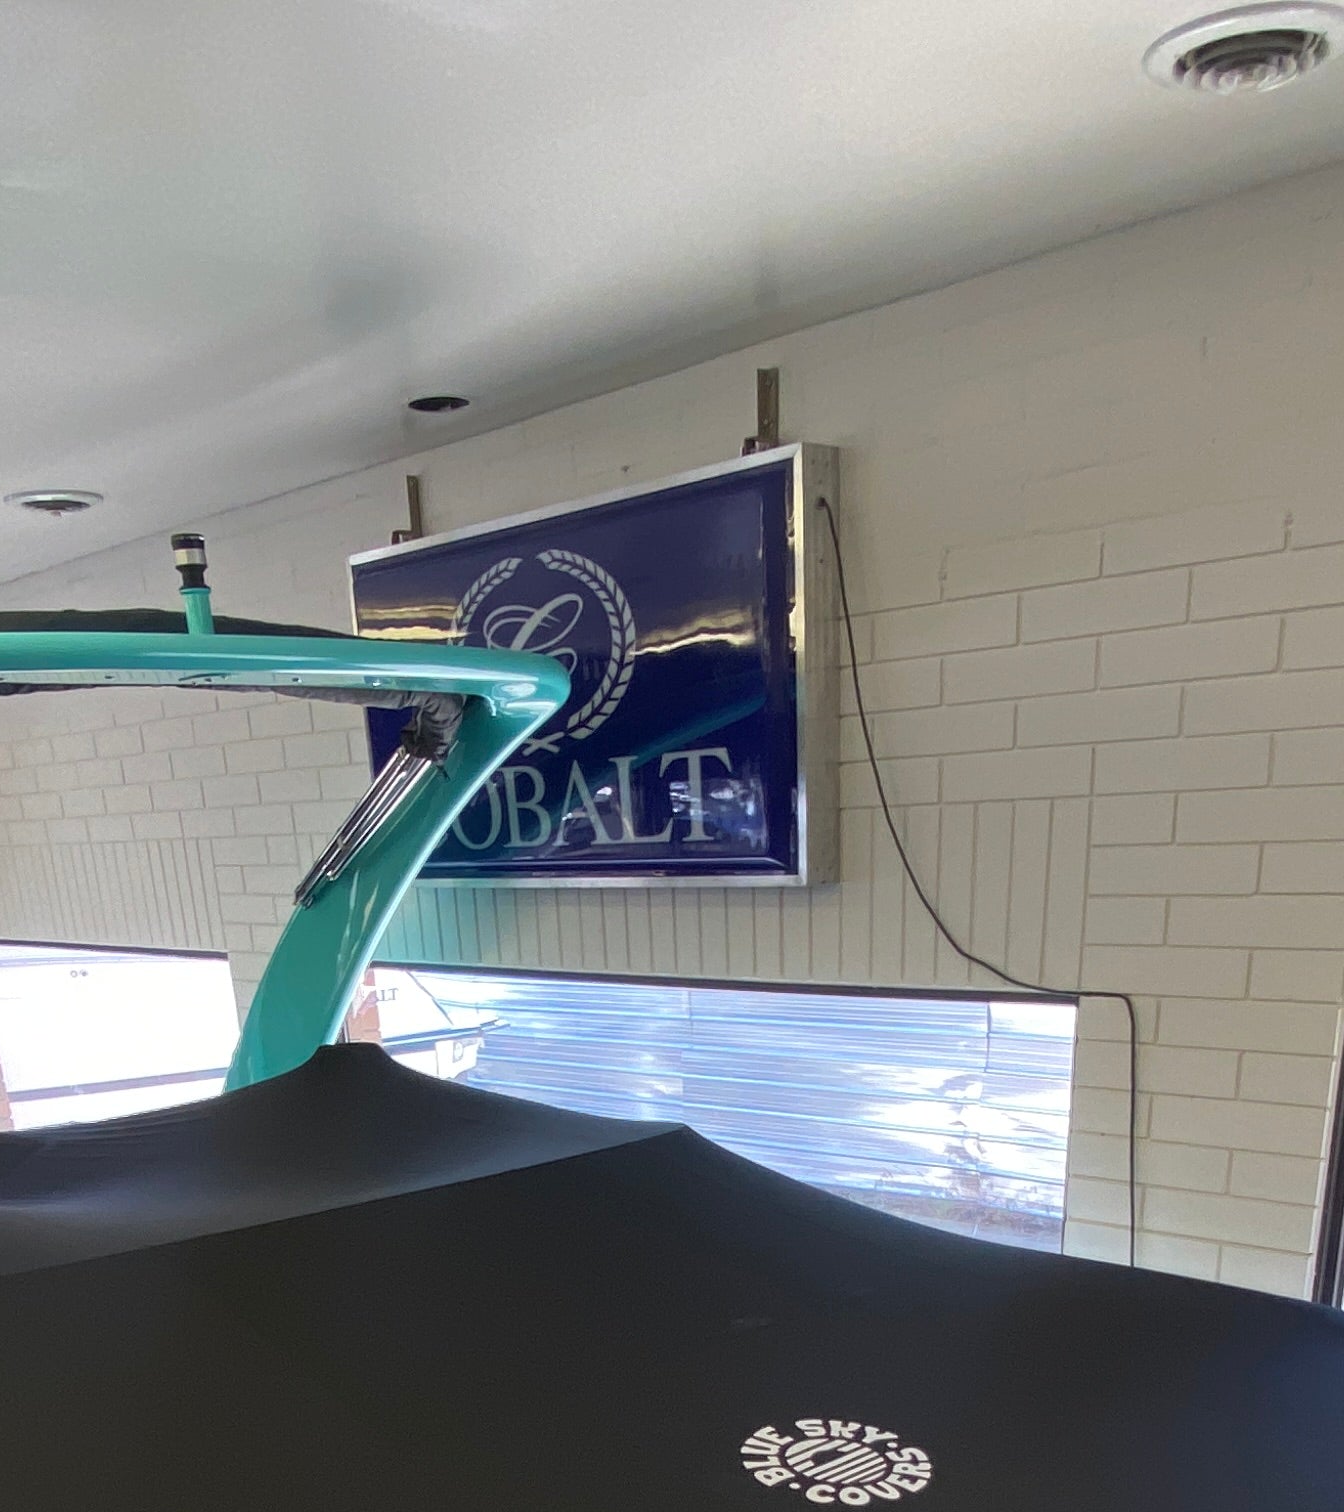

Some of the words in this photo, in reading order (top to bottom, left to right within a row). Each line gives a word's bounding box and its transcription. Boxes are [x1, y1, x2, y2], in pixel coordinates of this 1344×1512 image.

[442, 747, 732, 850] OBALT
[740, 1426, 795, 1488] BLUE
[794, 1418, 899, 1444] SKY
[805, 1447, 932, 1507] COVERS
